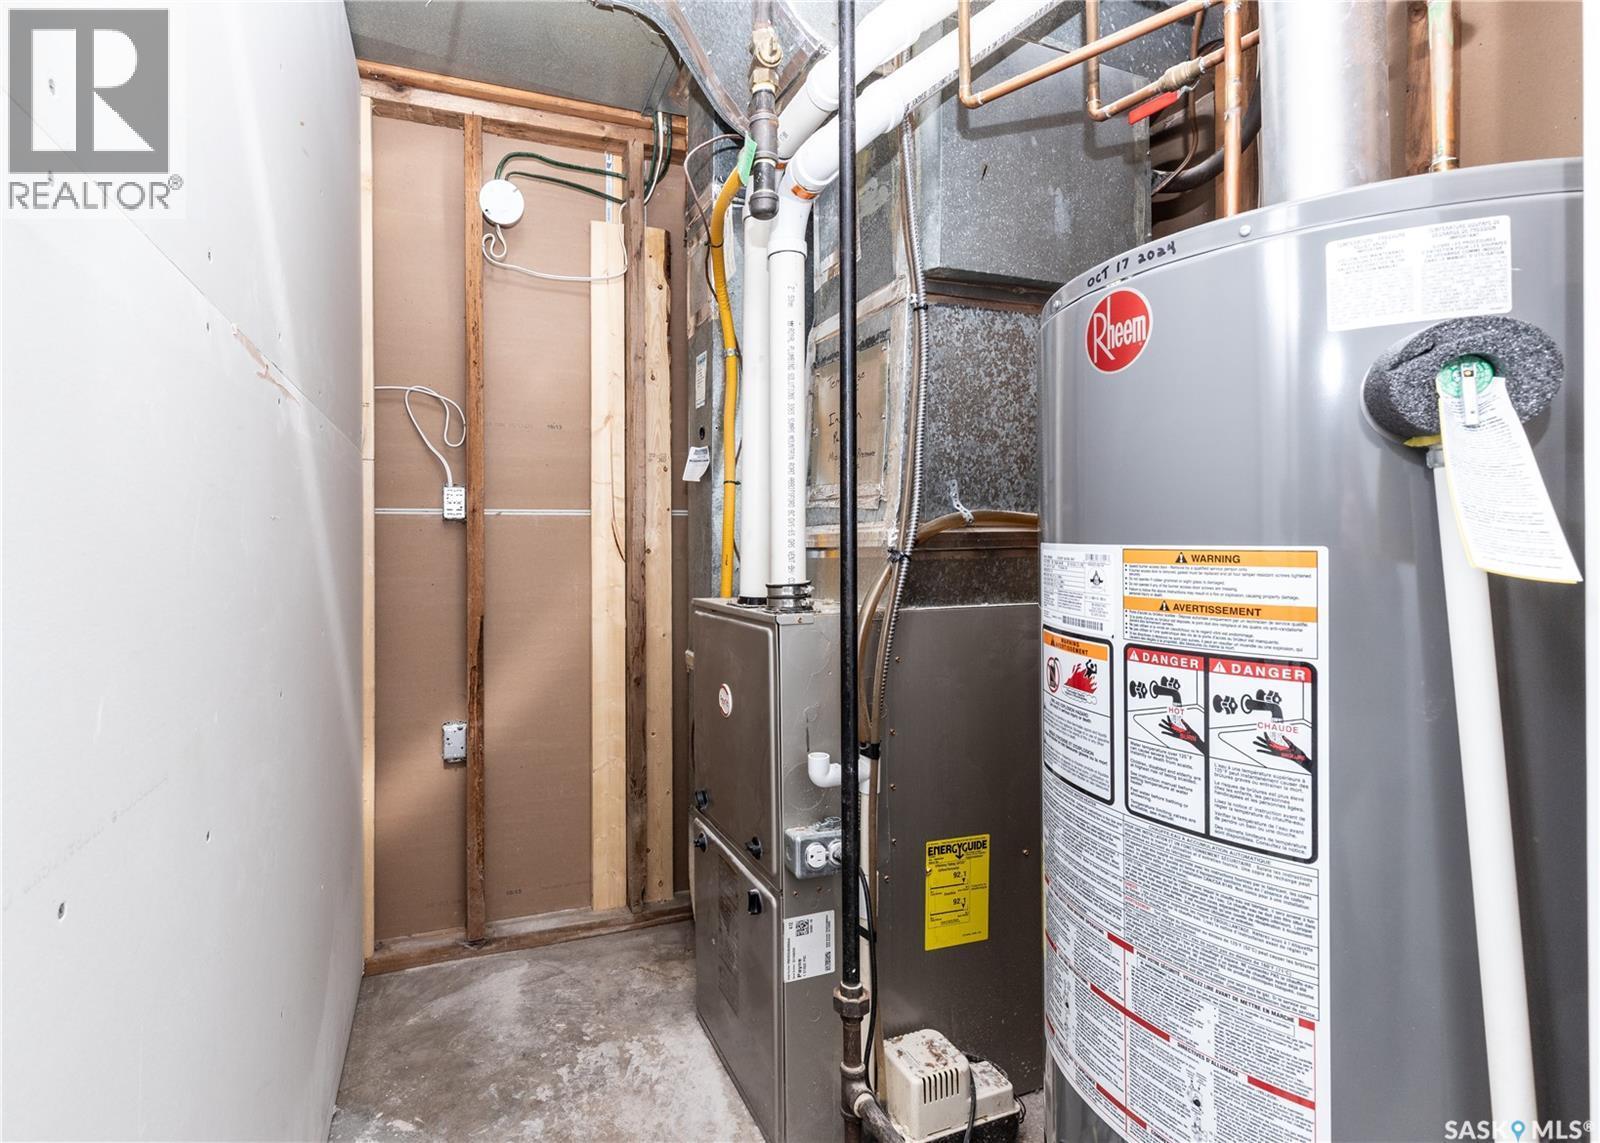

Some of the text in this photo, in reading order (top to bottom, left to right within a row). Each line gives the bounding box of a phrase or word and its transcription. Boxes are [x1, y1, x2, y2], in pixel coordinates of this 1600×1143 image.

[1087, 241, 1176, 287] OCT 17 2024
[1093, 297, 1148, 363] Rheem
[1191, 554, 1241, 564] WARNING
[1173, 603, 1262, 617] AVERTISSEMENT
[1143, 653, 1199, 669] DANGER
[1231, 663, 1306, 680] DANGER
[1168, 707, 1185, 715] HOT
[1257, 721, 1299, 734] CHAUDE
[928, 840, 987, 857] ENERGYGUIDE
